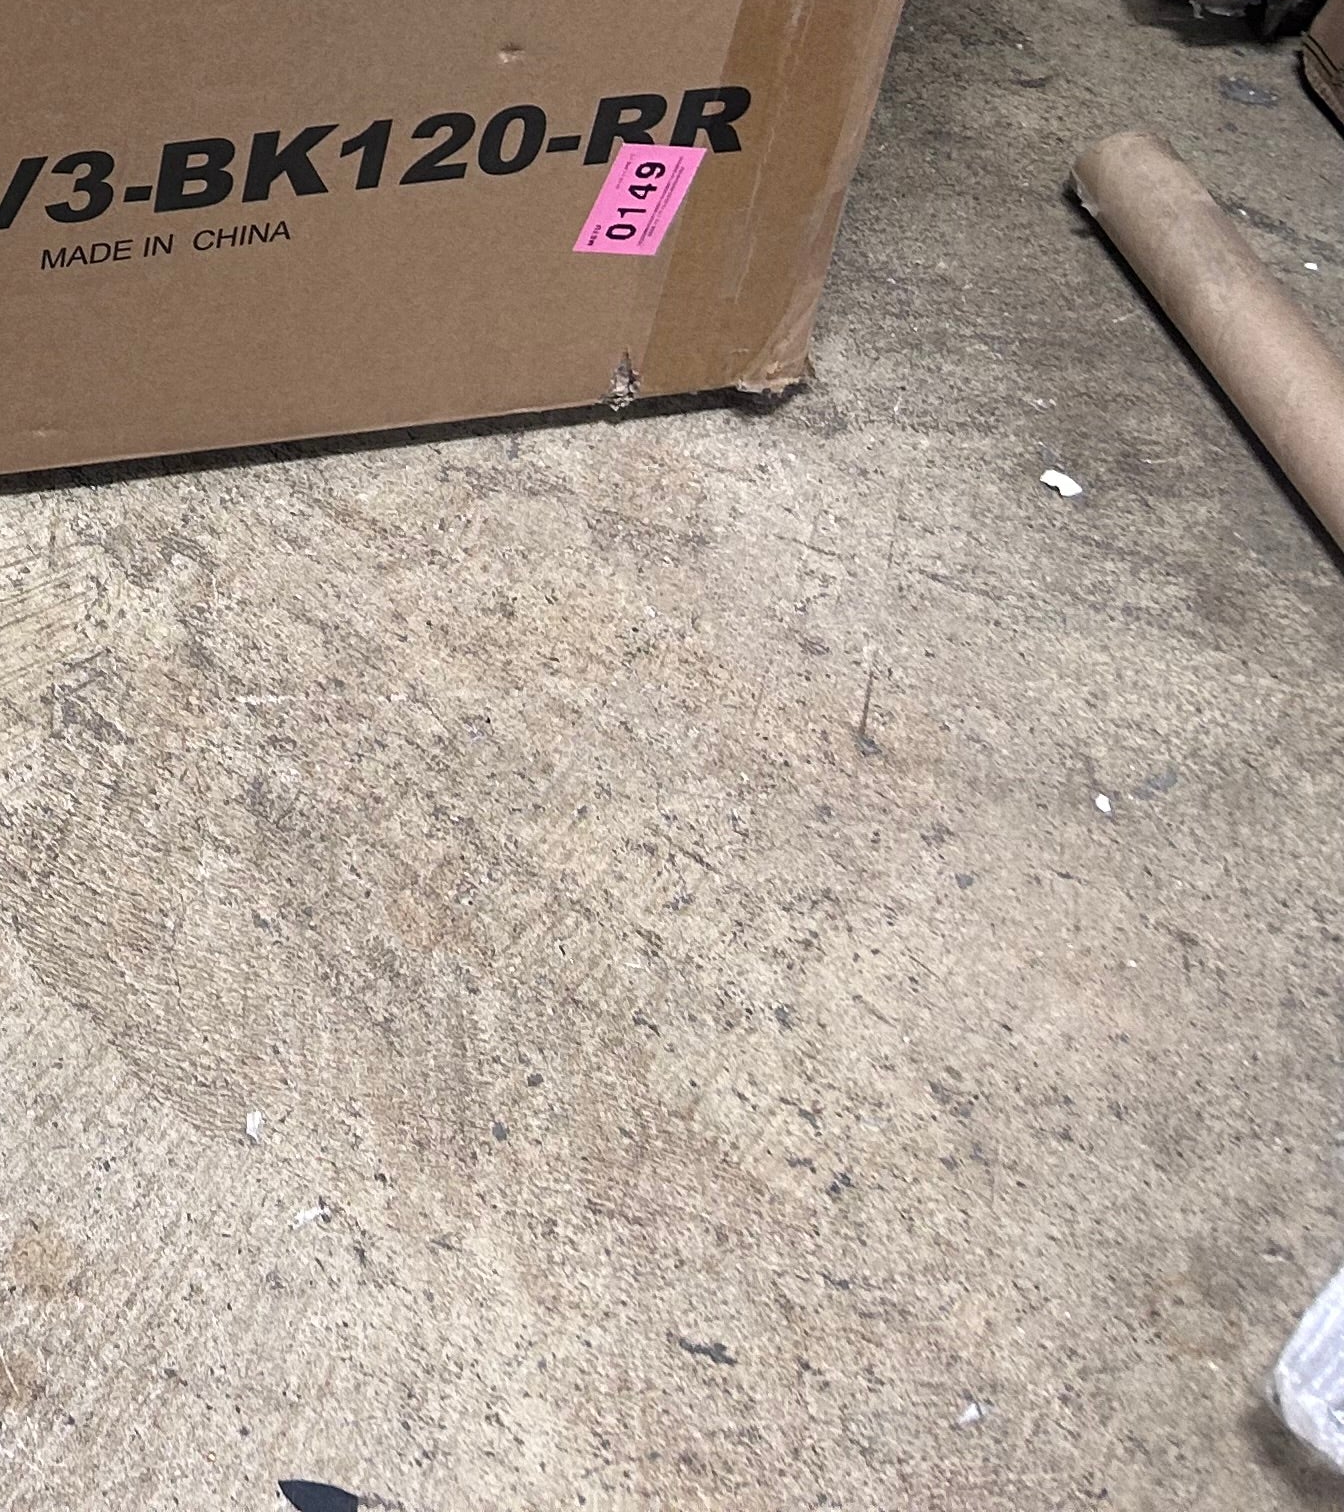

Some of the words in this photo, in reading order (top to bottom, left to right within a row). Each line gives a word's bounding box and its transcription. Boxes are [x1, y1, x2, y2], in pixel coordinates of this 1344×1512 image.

[605, 161, 666, 241] 0149
[38, 237, 138, 272] MADE
[141, 233, 174, 260] IN
[190, 220, 292, 254] CHINA
